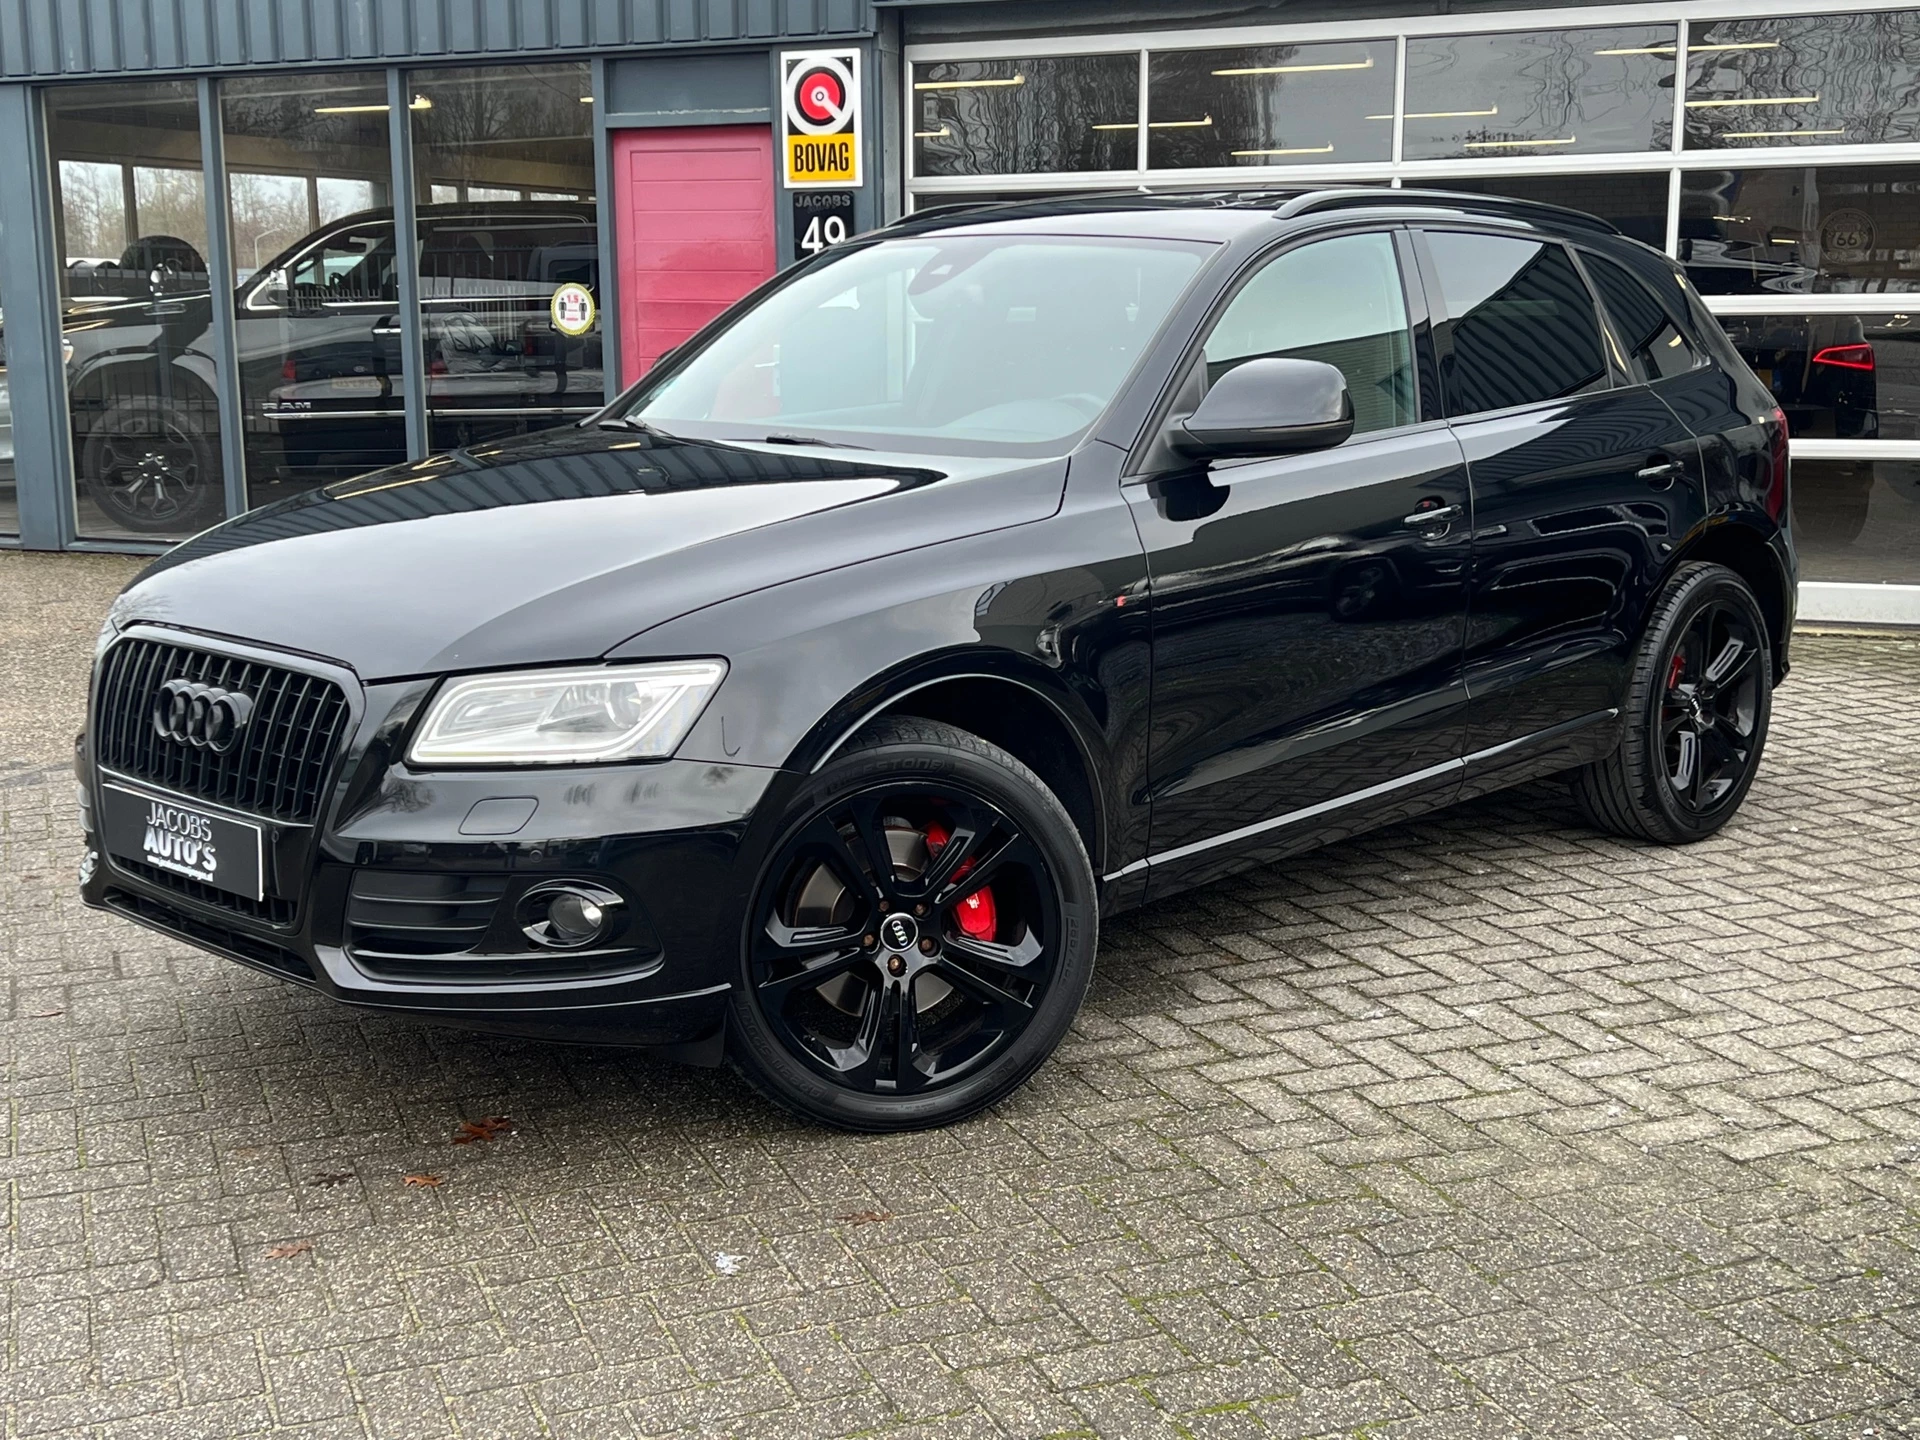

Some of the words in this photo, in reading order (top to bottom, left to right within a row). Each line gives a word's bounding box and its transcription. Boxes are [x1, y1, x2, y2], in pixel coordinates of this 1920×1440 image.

[793, 142, 849, 172] BOVAG
[795, 194, 851, 208] JACOBS
[801, 215, 846, 254] 49
[1837, 231, 1858, 247] 66
[261, 401, 311, 410] RAM
[146, 802, 212, 842] JACOBS
[143, 826, 217, 872] AUTO'S
